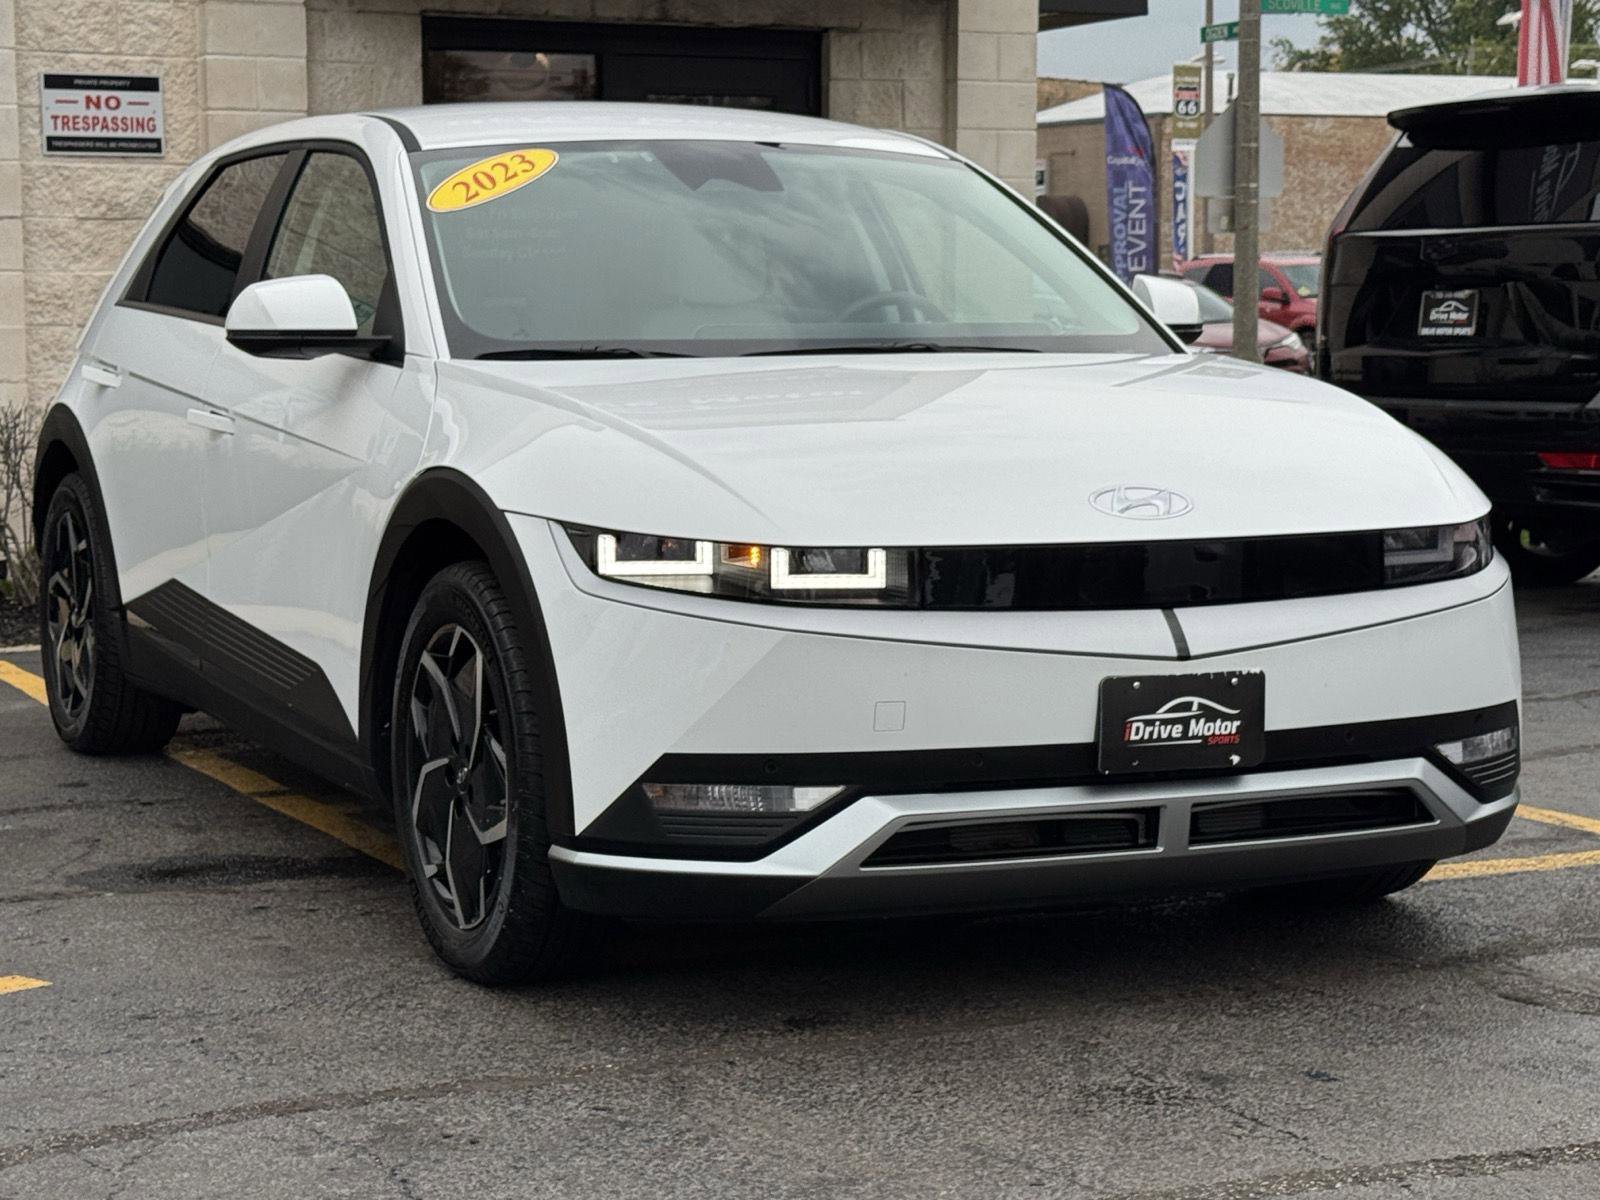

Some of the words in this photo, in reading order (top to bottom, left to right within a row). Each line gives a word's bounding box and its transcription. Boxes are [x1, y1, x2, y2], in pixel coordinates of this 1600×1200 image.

[84, 94, 121, 111] NO
[1177, 99, 1198, 115] 66
[50, 114, 157, 134] TRESPASSING
[451, 153, 536, 203] 2023
[1128, 180, 1147, 272] EVENT
[1123, 721, 1183, 742] iDrive
[1188, 717, 1242, 737] Motor
[1207, 735, 1240, 745] SPORTS
